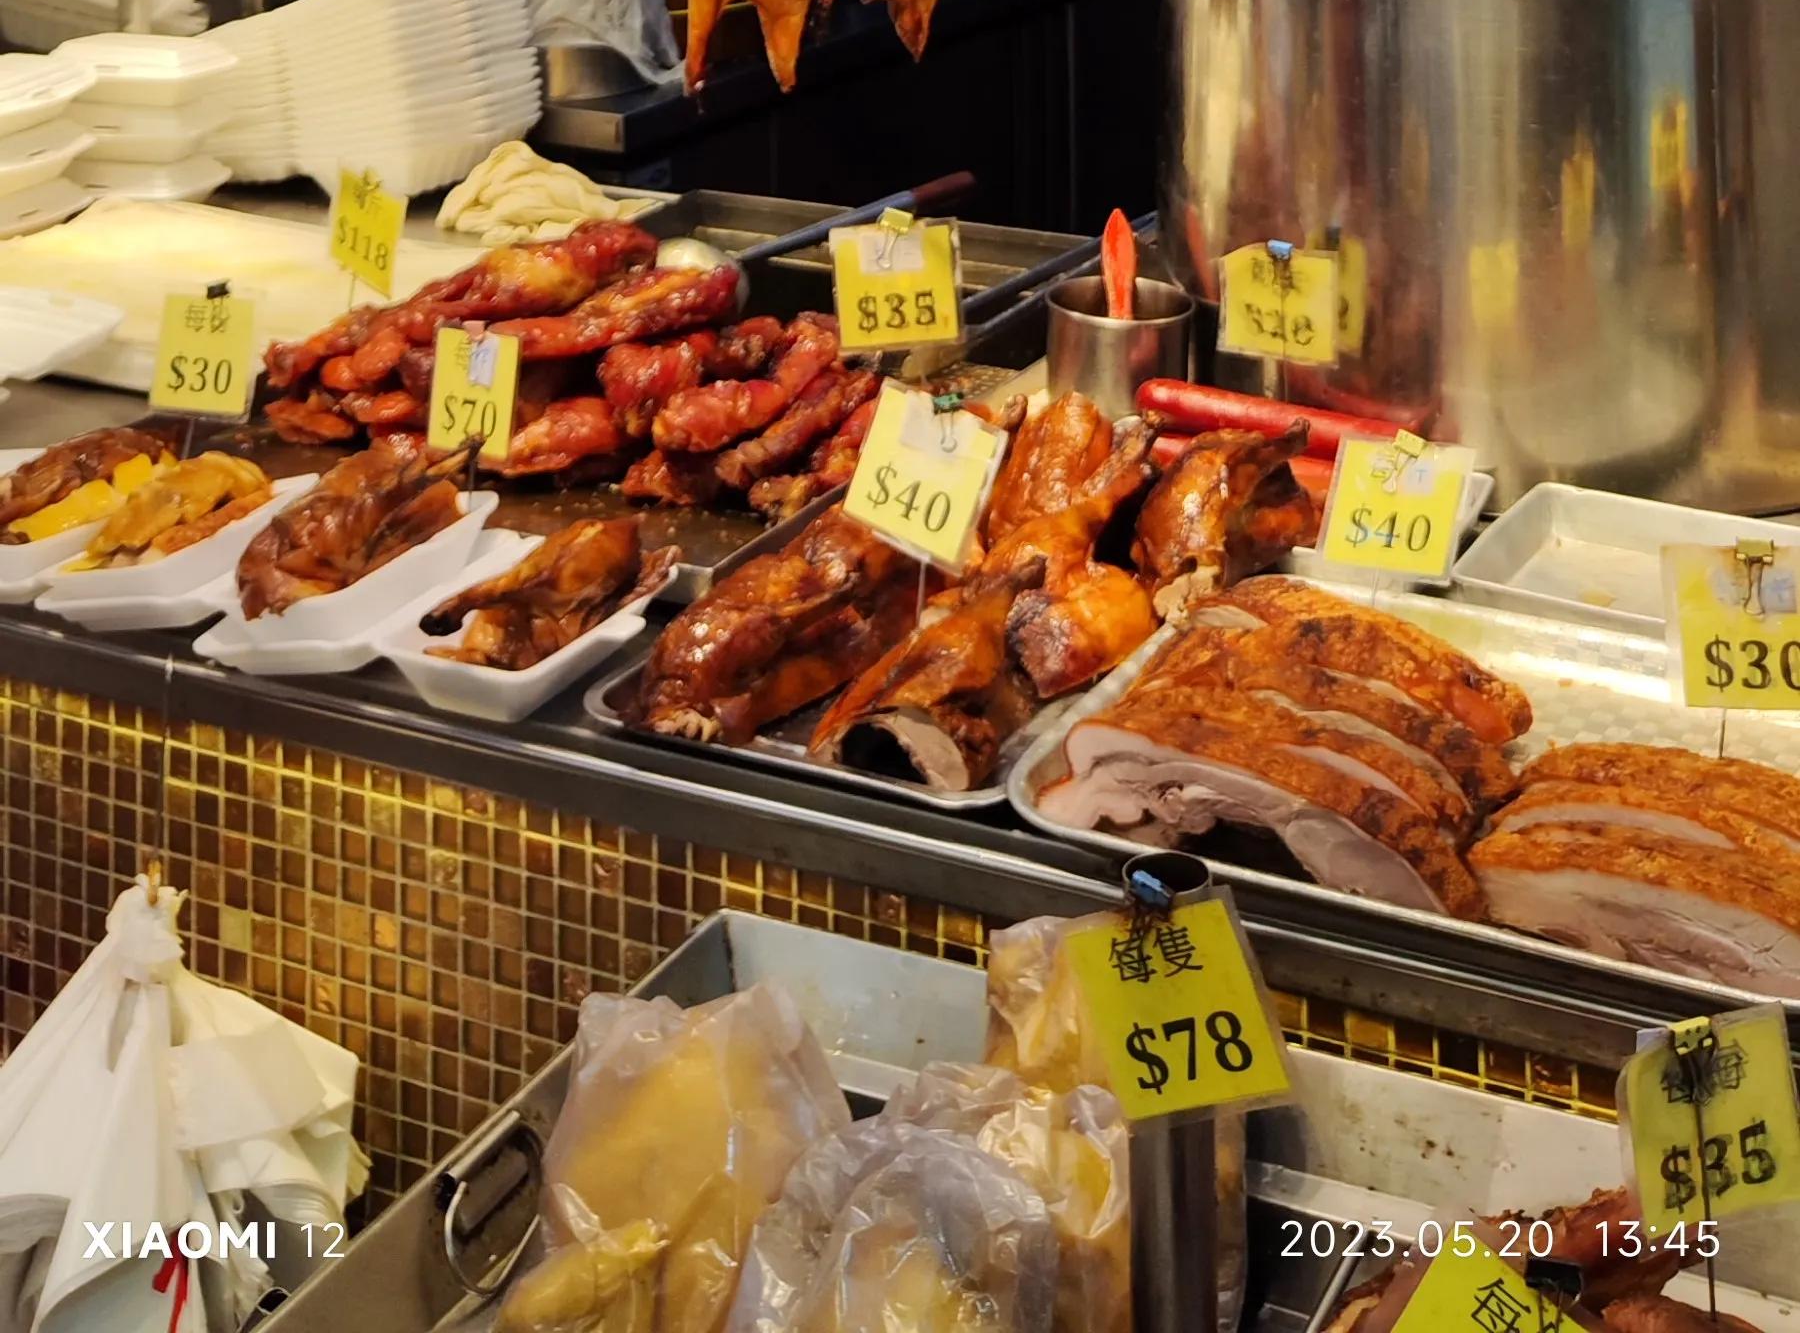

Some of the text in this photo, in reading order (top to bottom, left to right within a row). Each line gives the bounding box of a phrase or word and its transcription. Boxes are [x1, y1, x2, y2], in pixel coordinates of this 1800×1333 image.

[336, 214, 389, 271] $118
[856, 290, 937, 334] $35
[166, 351, 232, 395] $30
[441, 391, 498, 439] $70
[866, 461, 952, 533] $40
[1344, 502, 1432, 552] $40
[1126, 1010, 1253, 1095] $78
